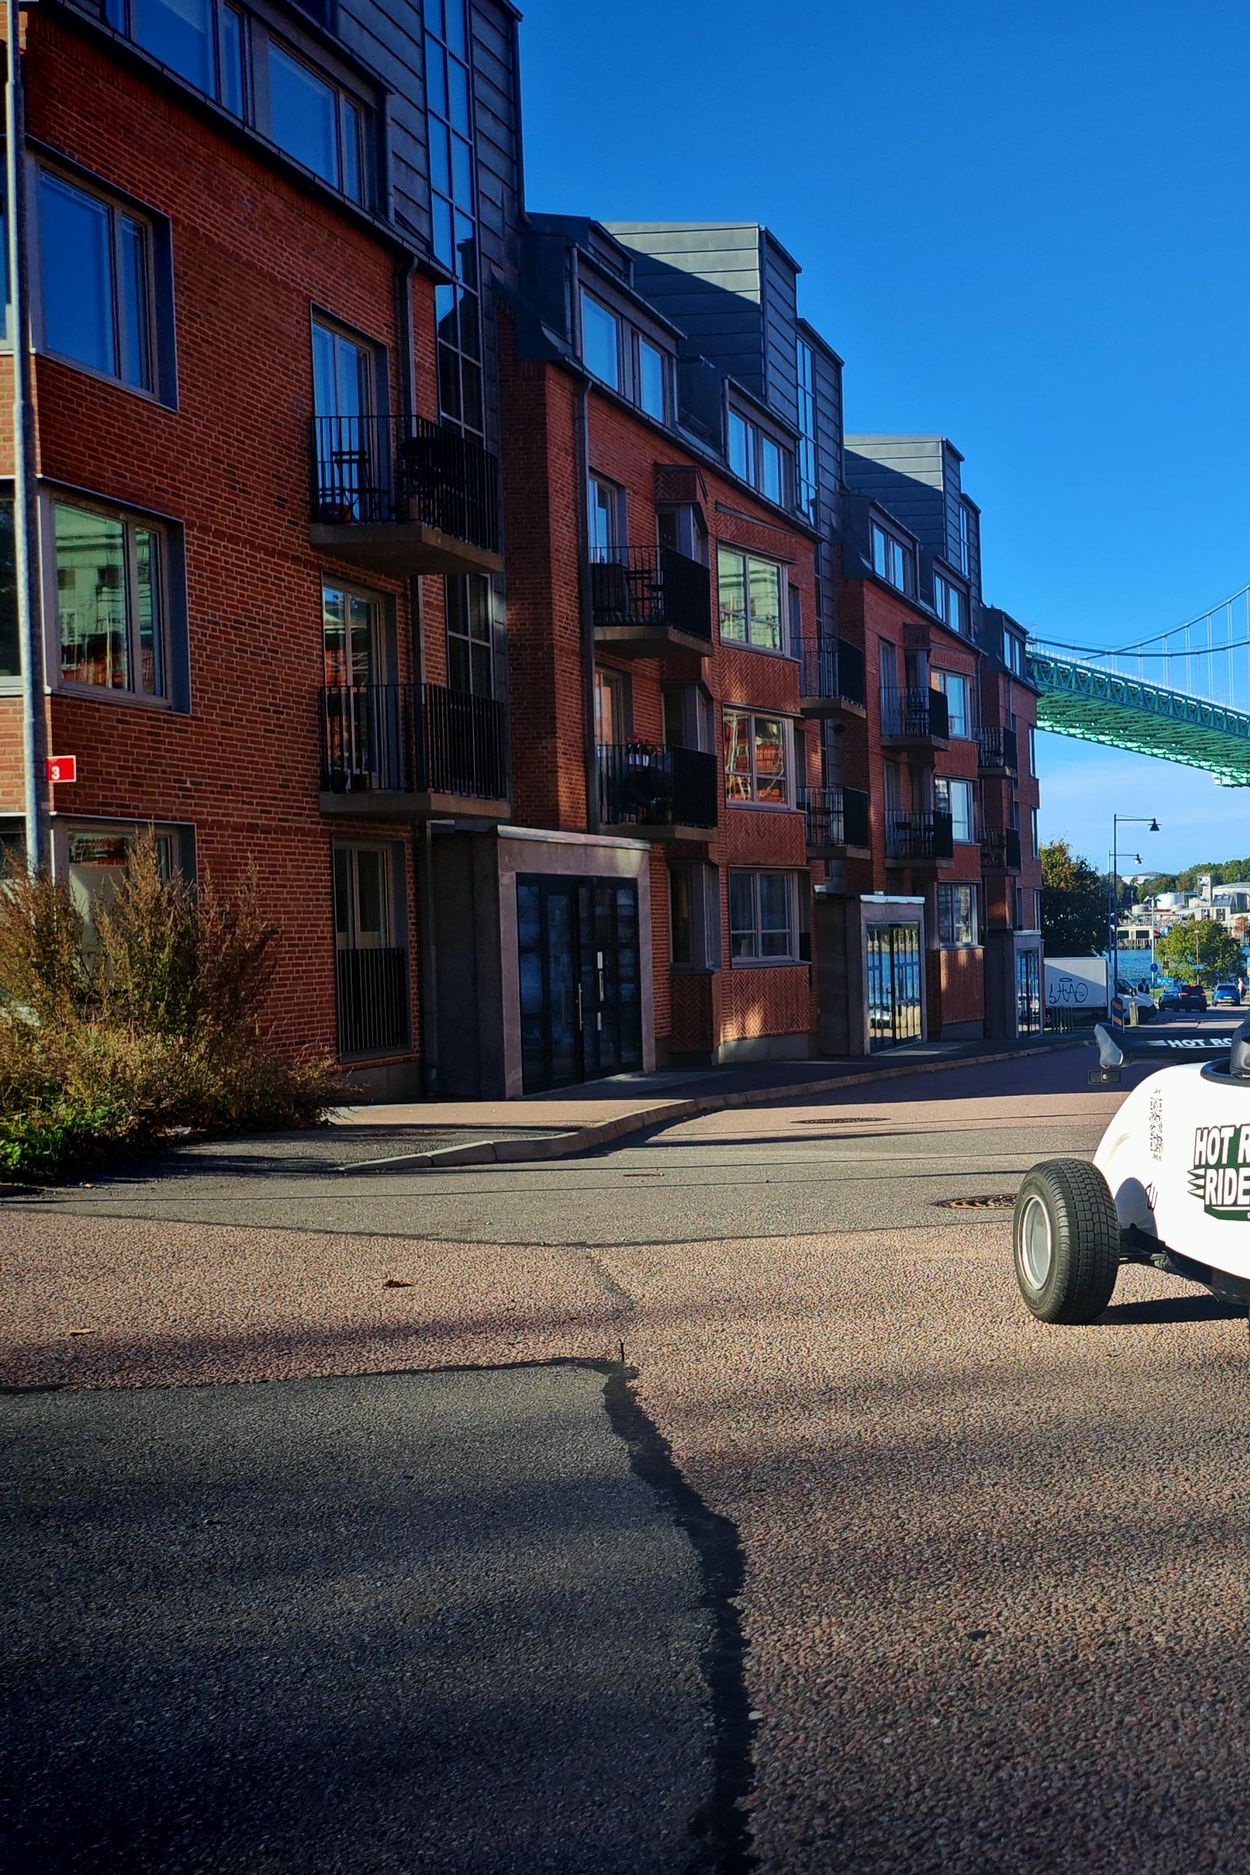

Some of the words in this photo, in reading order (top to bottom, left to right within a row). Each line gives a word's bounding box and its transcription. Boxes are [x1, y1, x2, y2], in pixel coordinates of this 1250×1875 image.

[51, 765, 60, 780] 3
[1168, 1039, 1206, 1048] HOT
[1210, 1038, 1232, 1046] RO
[1194, 1125, 1236, 1166] HOT
